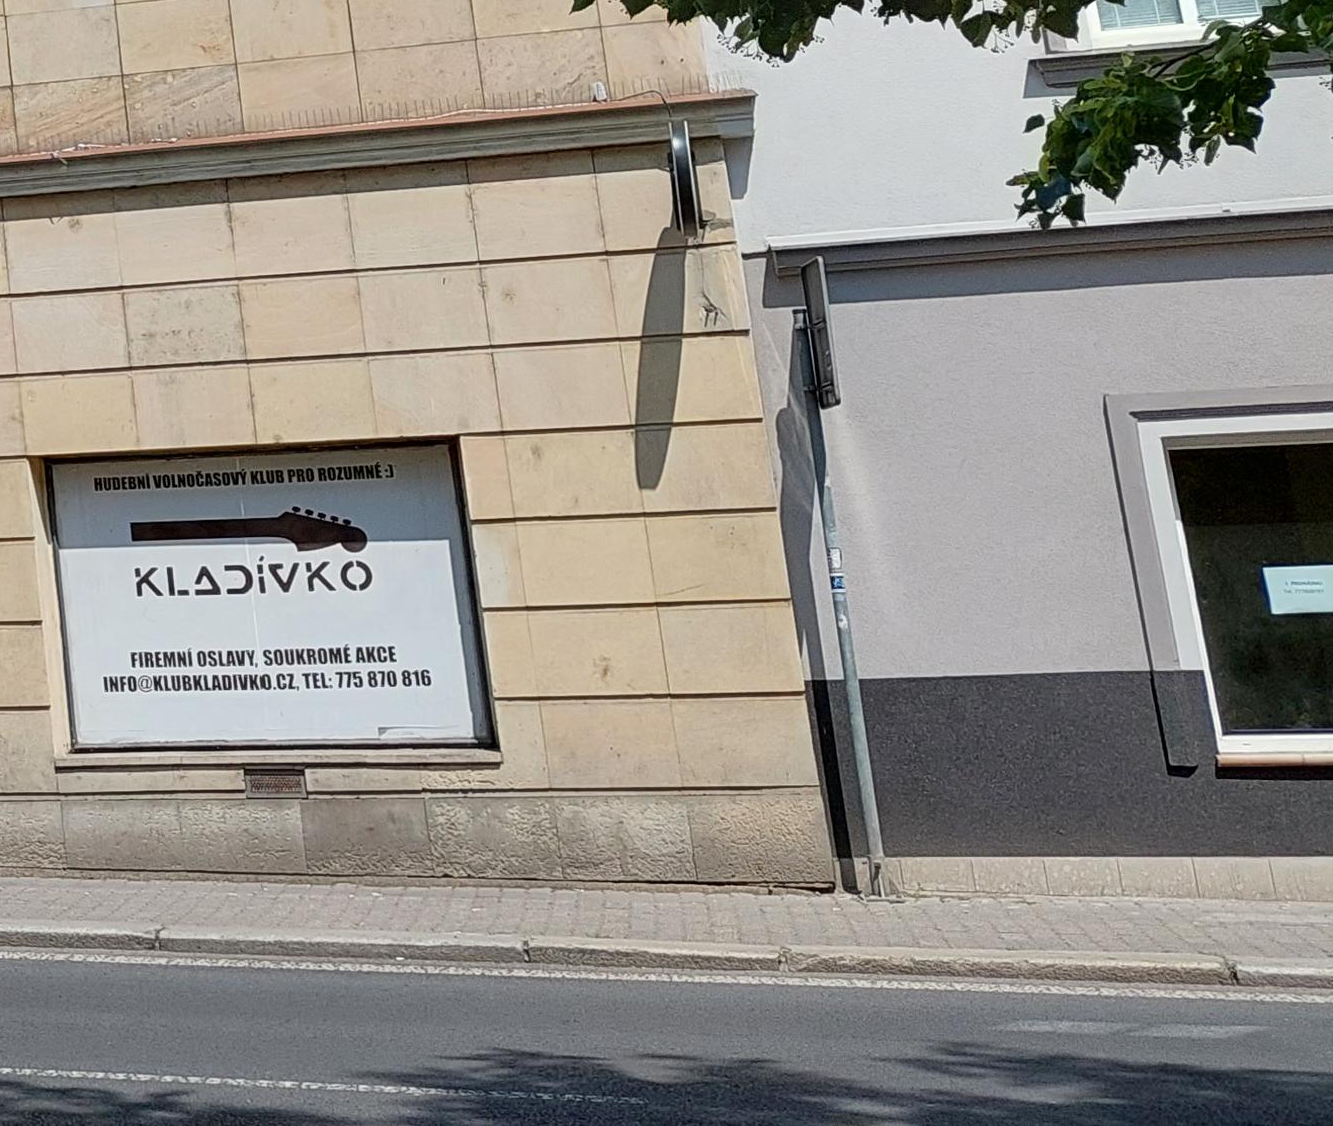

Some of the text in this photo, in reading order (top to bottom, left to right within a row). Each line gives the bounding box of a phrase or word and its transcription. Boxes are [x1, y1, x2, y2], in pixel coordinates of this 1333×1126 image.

[93, 474, 151, 492] HUDEBNÍ
[153, 468, 247, 489] VOLNOČASOVÝ
[250, 469, 284, 485] KLUB
[287, 467, 315, 483] PRO
[317, 462, 382, 481] ROZUMNÉ
[134, 555, 373, 597] KLADÍVKO
[130, 644, 397, 668] FIREMNÍ OSLAVY, SOUKROMÉ AKCE
[103, 669, 432, 693] INFO@KLUBKLADIVKO.CZ, TEL: 775 870 816
